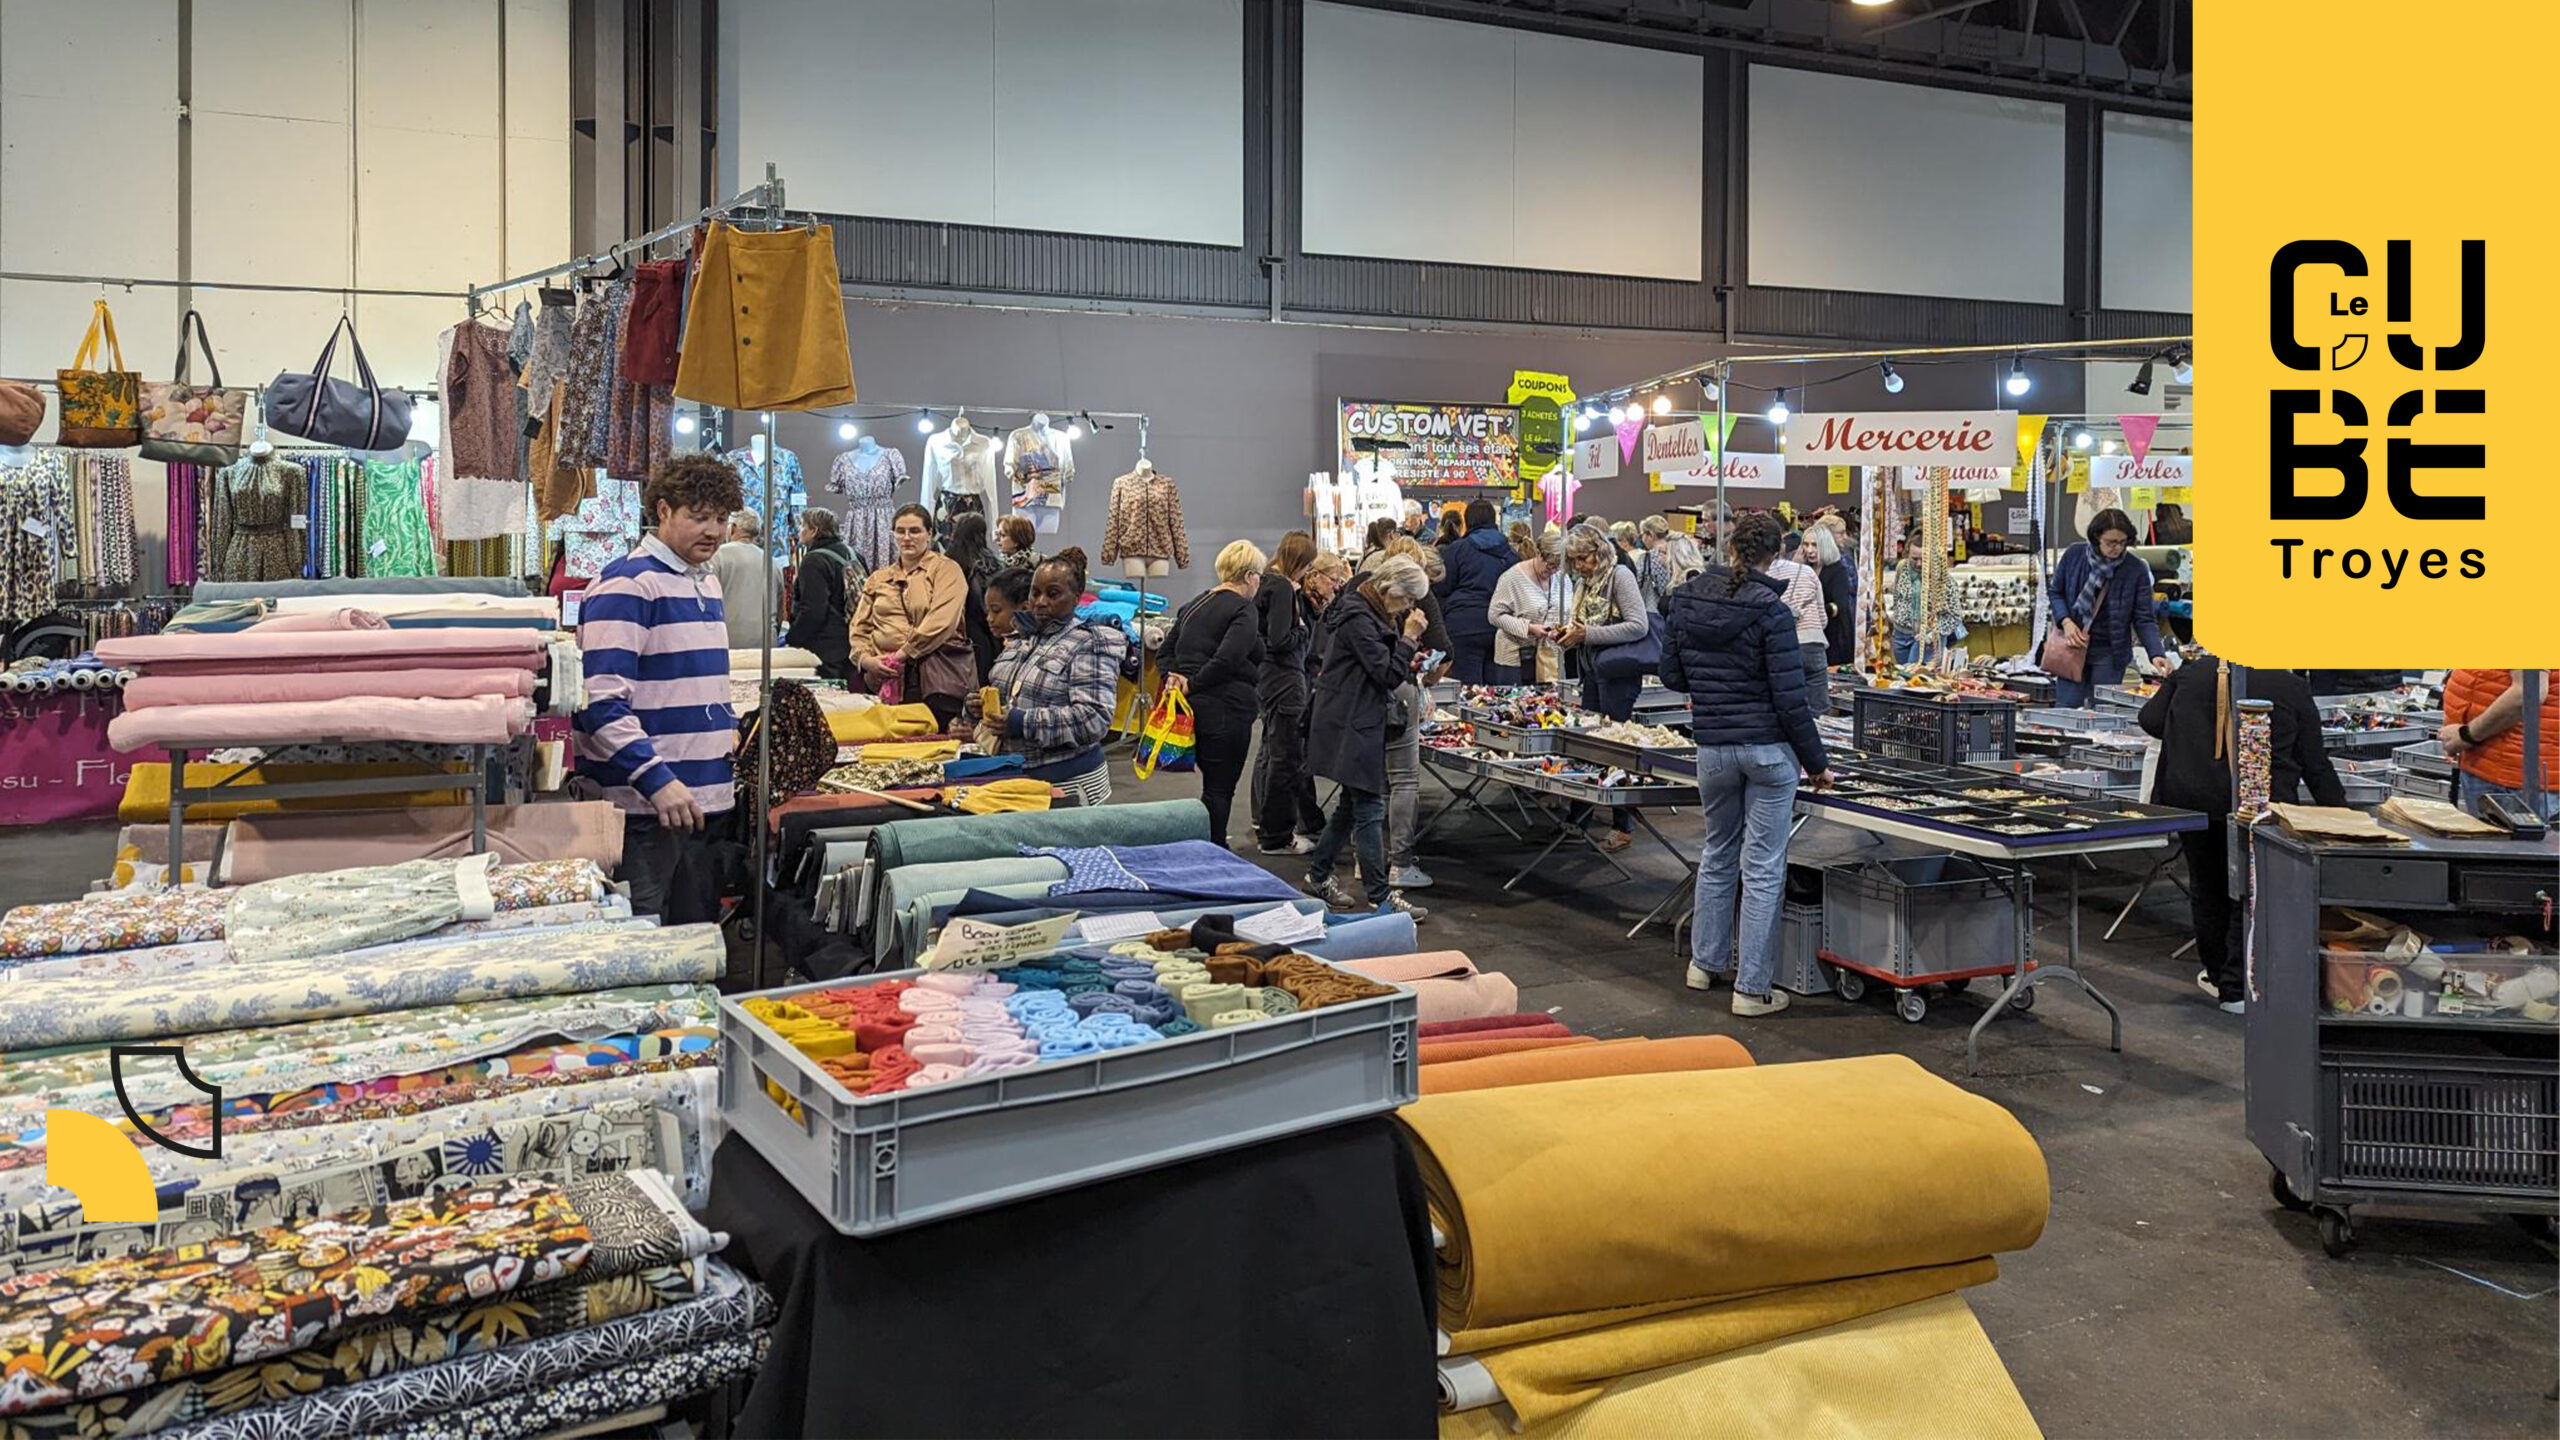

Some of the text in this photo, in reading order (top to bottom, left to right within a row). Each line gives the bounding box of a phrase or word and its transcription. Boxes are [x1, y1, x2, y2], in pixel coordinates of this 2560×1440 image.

[1518, 379, 1567, 394] COUPONS
[1347, 411, 1451, 436] CUSTOM
[1806, 417, 1994, 451] Mercerie
[1459, 444, 1479, 454] ses
[1647, 428, 1699, 462] Dentelles
[1588, 443, 1601, 470] Fil
[1915, 466, 2000, 481] utons
[2116, 460, 2183, 480] Perles
